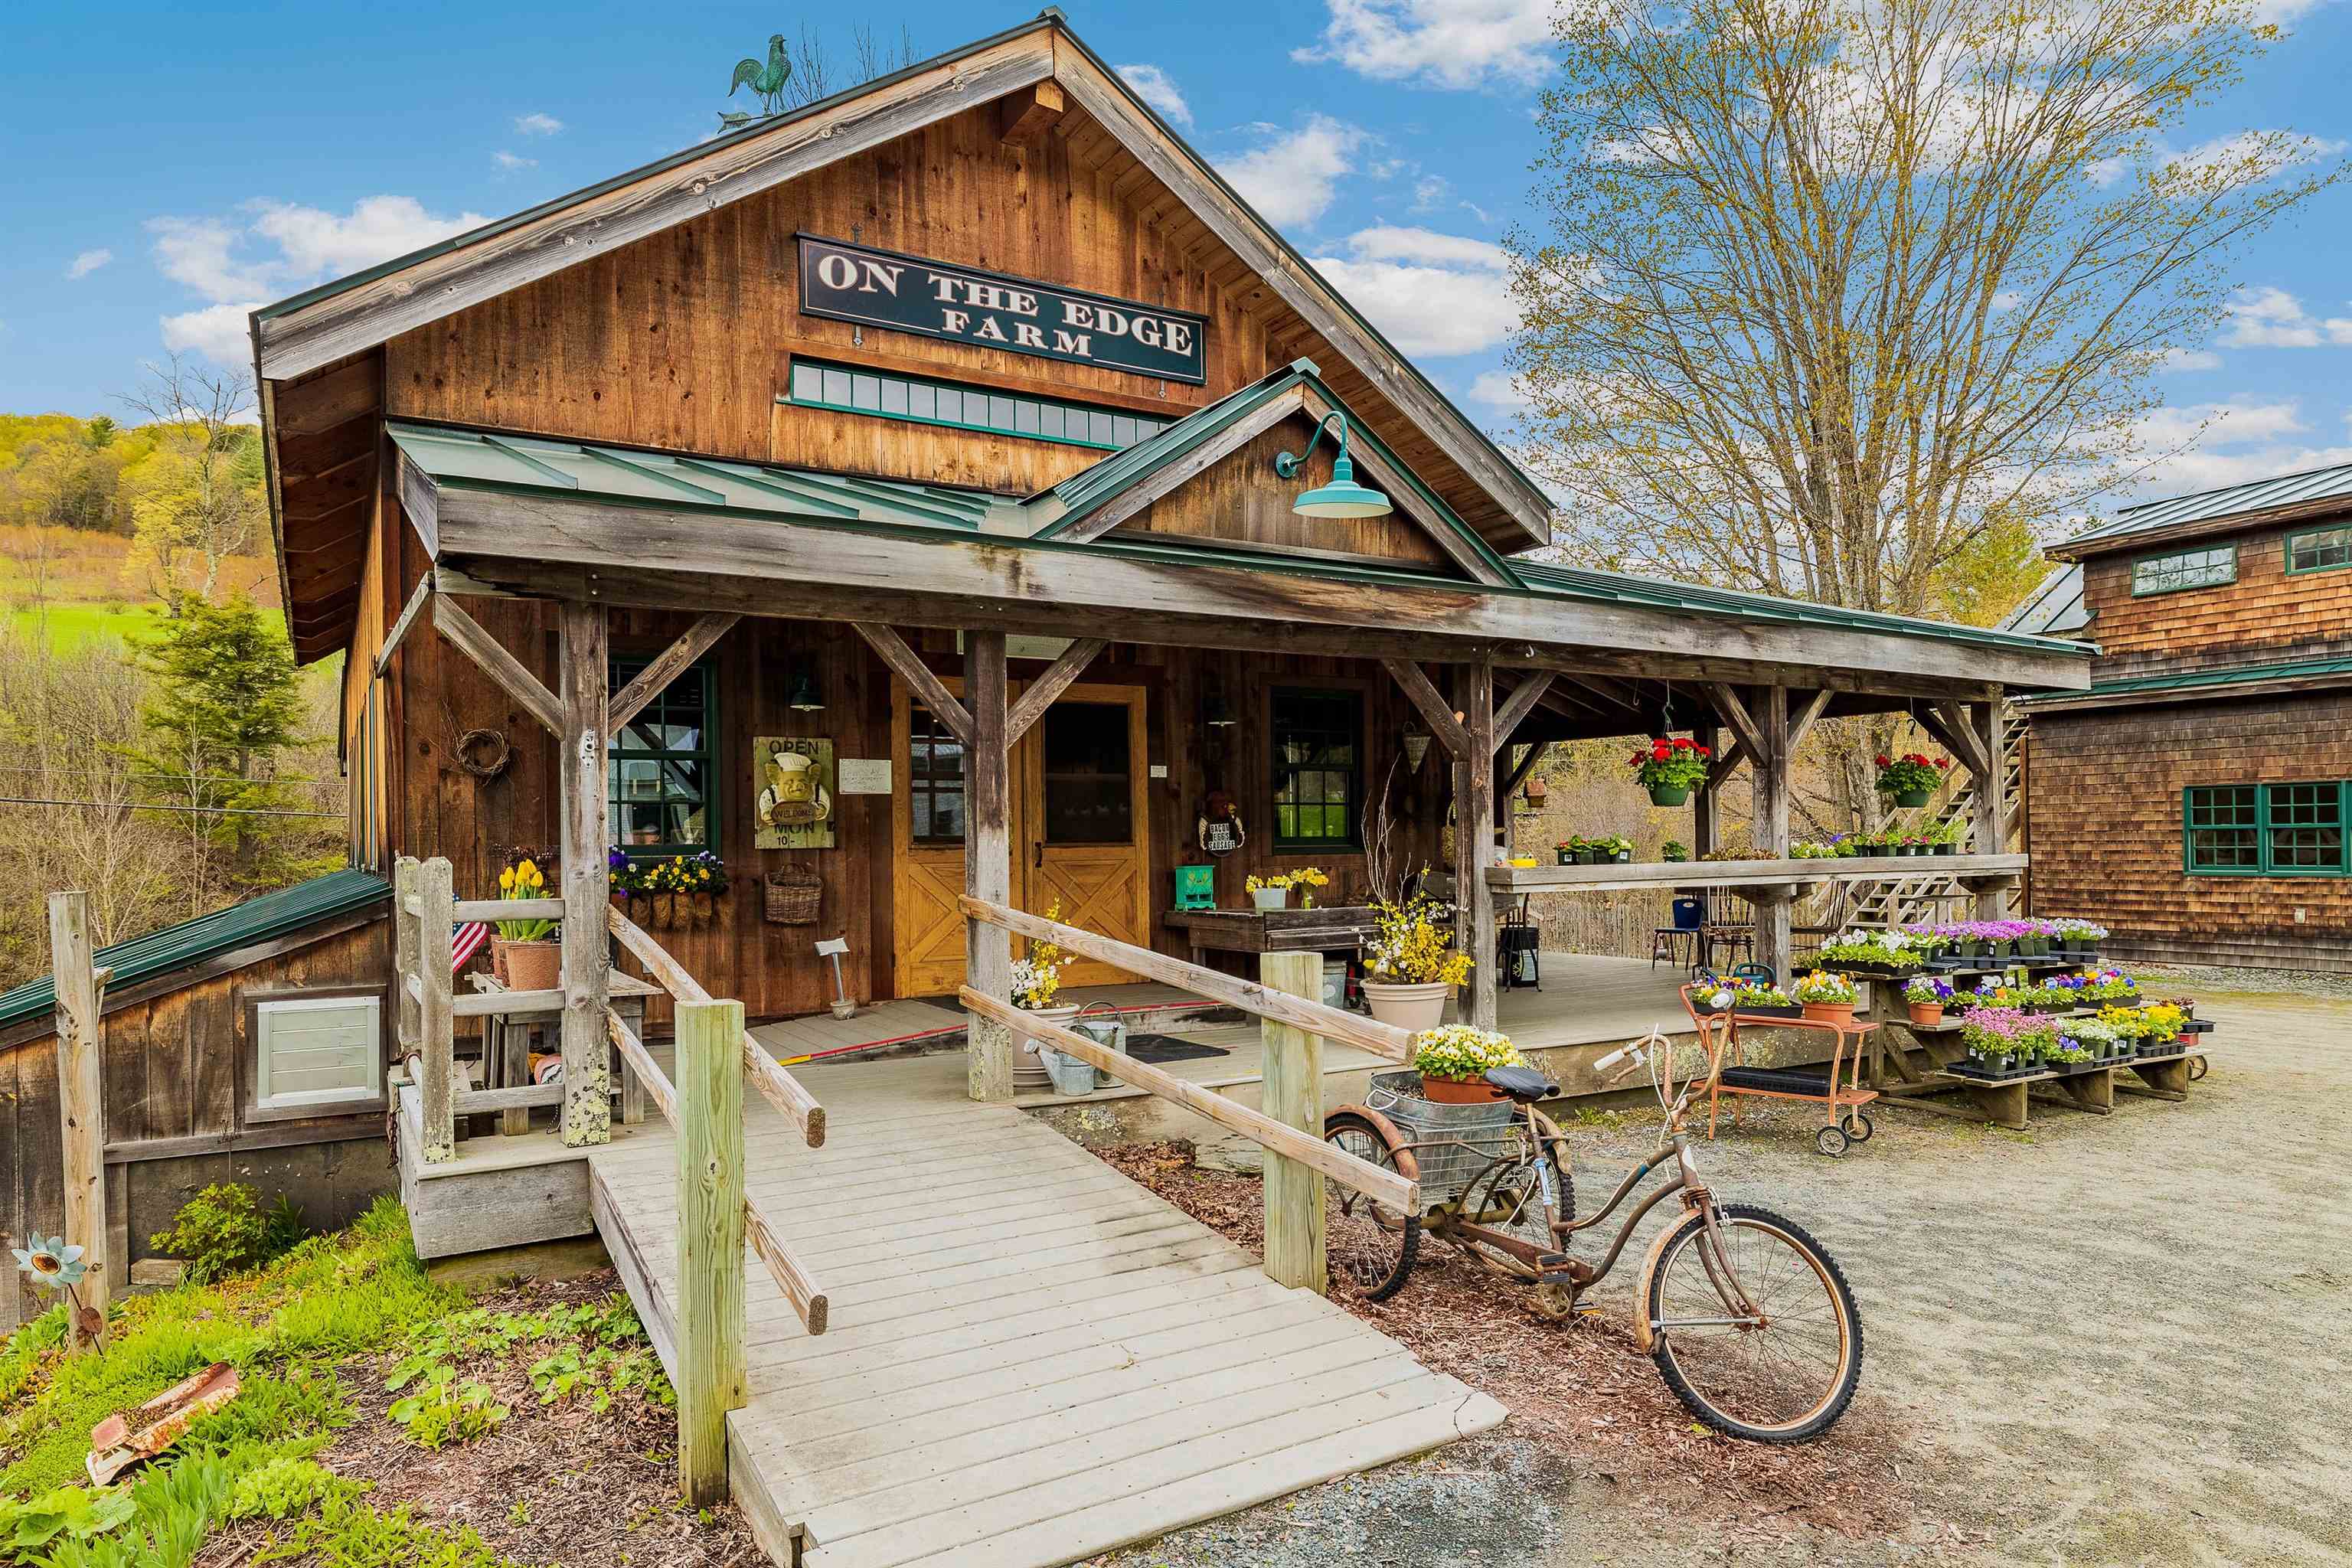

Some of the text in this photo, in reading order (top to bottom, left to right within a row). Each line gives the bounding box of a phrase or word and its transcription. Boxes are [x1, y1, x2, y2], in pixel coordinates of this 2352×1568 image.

[818, 254, 1193, 357] ON THE EDGE
[941, 309, 1093, 358] FARM
[769, 740, 819, 755] OPEN
[776, 808, 812, 818] WELCOME
[1210, 823, 1230, 833] BACON
[1213, 832, 1230, 841] EGGS
[1208, 840, 1235, 850] SAUSAGE
